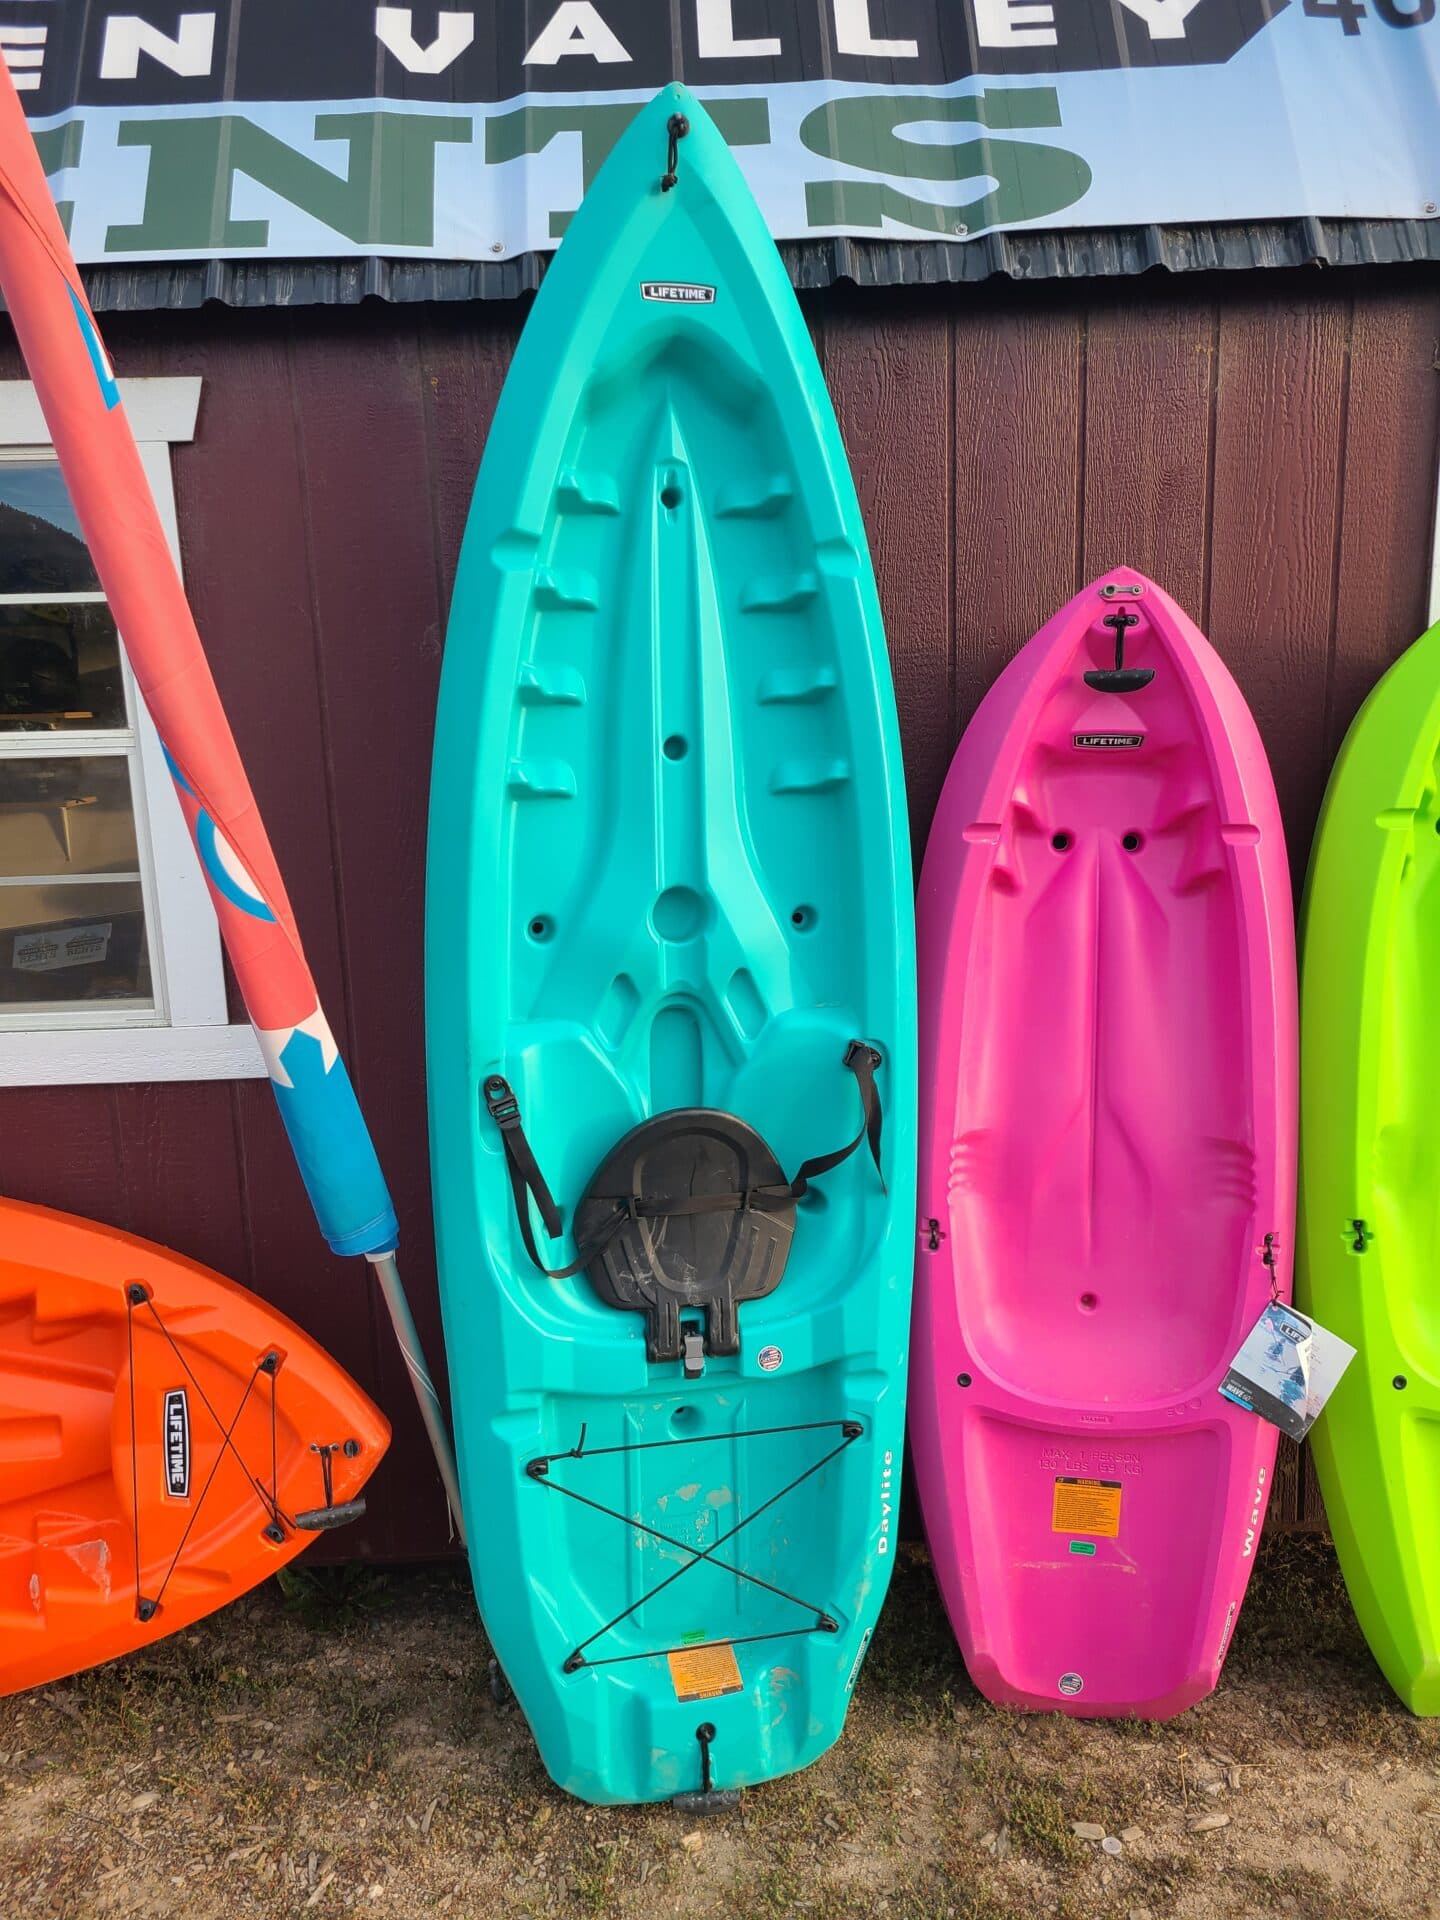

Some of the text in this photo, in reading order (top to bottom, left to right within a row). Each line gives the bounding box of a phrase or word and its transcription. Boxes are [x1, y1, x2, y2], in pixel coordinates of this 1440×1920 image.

[375, 0, 1203, 74] VALLEY
[650, 286, 706, 300] LIFETIME
[1082, 737, 1134, 745] LIFETIME
[169, 1403, 184, 1485] LIFETIME
[1091, 1451, 1140, 1464] PERSON
[877, 1450, 892, 1554] Daylite
[1242, 1467, 1266, 1558] Wave
